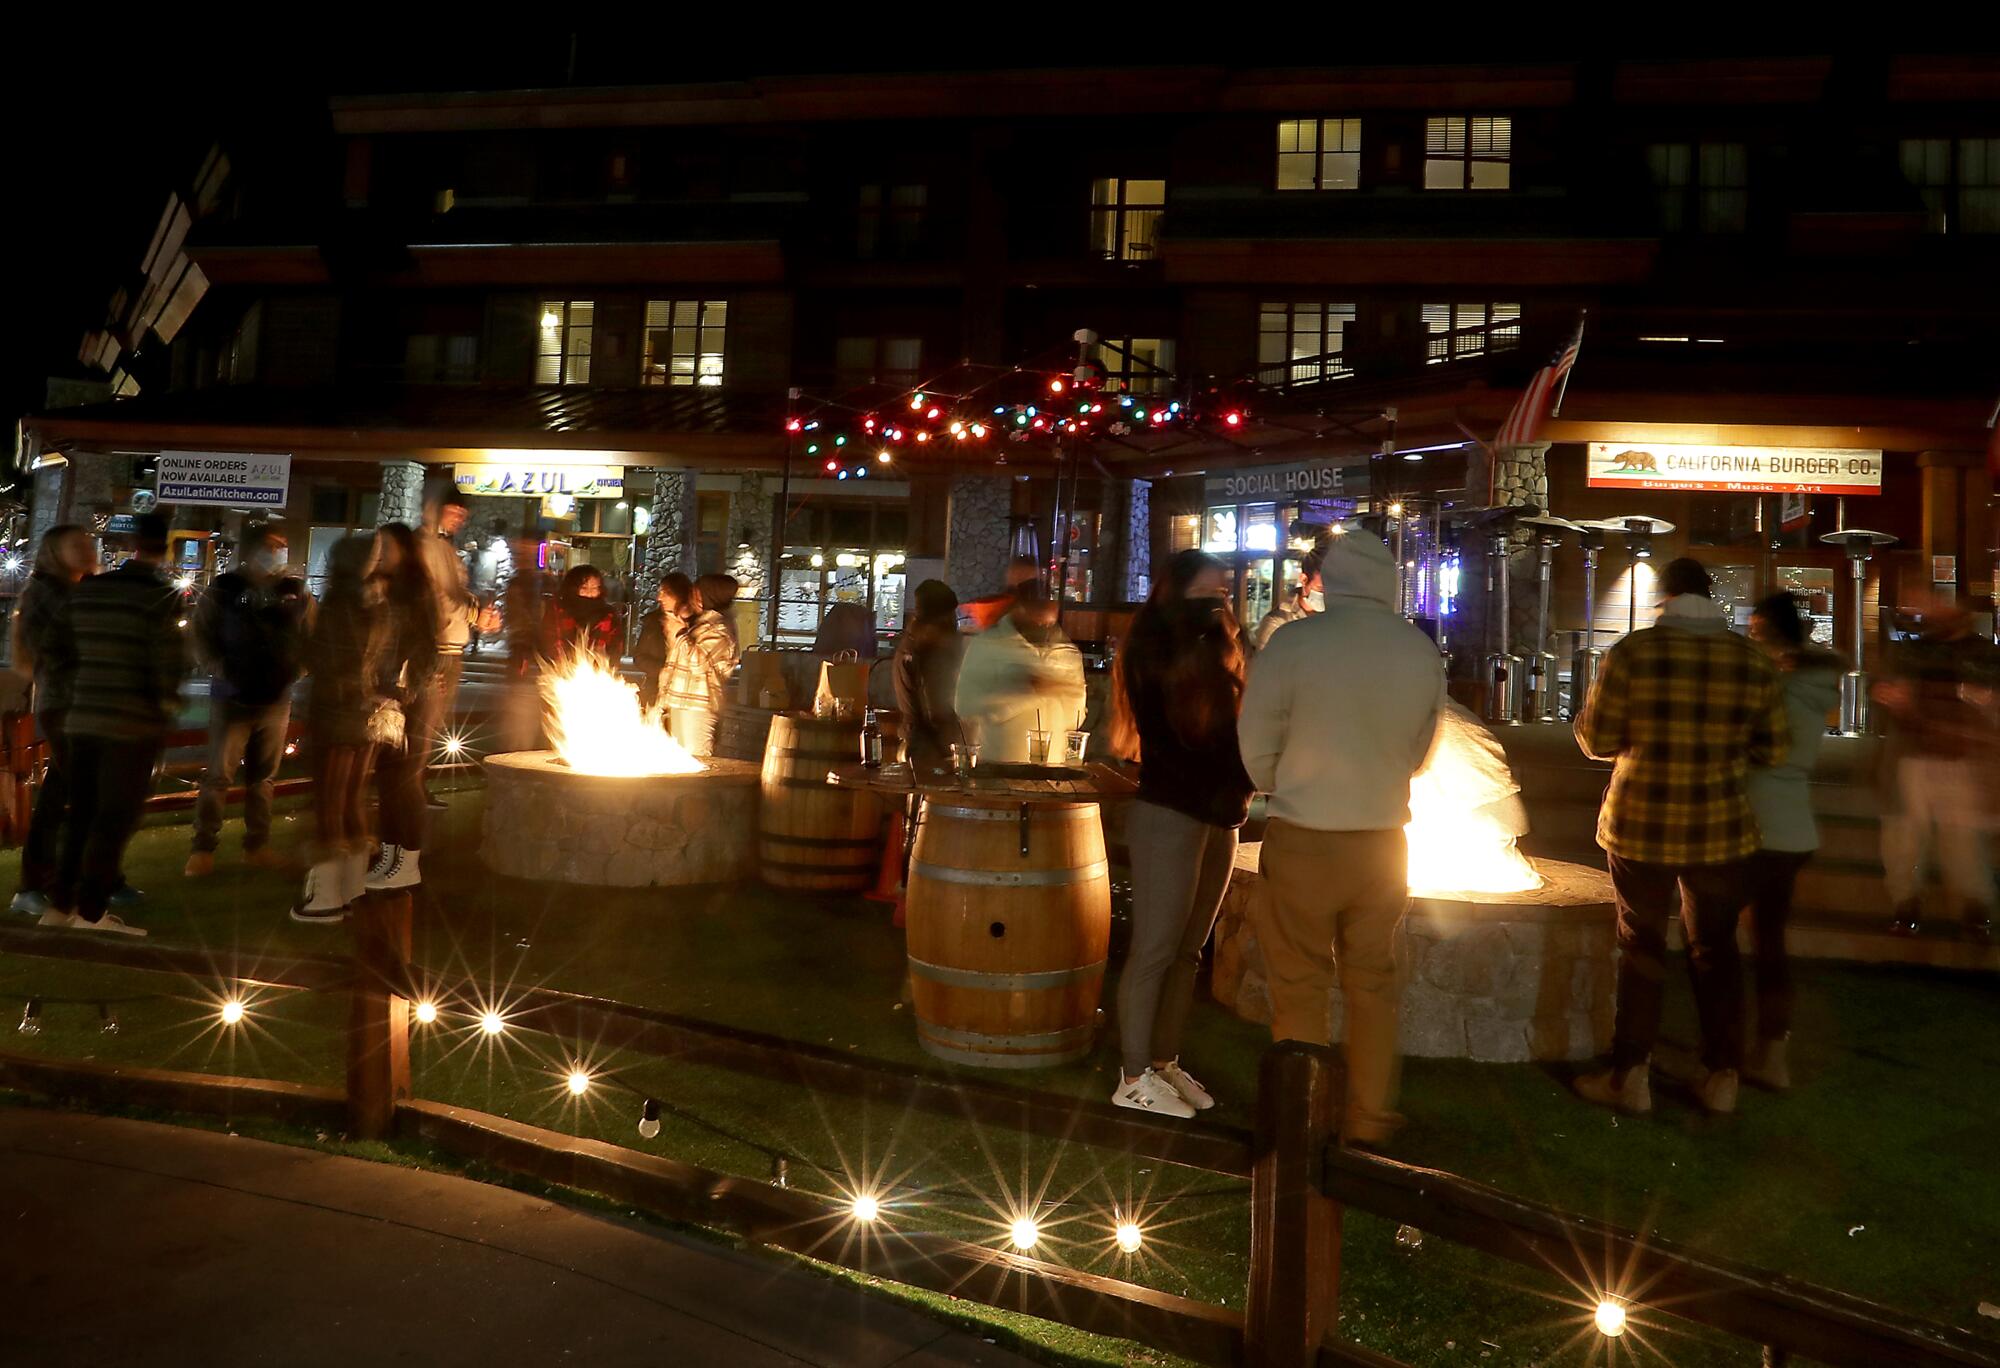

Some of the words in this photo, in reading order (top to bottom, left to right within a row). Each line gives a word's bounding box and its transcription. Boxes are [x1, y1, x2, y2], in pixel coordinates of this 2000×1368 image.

[163, 458, 201, 469] ONLINE
[203, 460, 247, 470] ORDERS
[251, 464, 284, 475] AZUL
[1667, 454, 1760, 472] CALIFORNIA
[1770, 457, 1839, 474] BURGER
[1848, 459, 1878, 475] CO.
[161, 471, 187, 481] NOW
[189, 473, 247, 483] AVAILABLE
[500, 472, 573, 495] AZUL
[1225, 473, 1280, 496] SOCIAL
[1286, 467, 1344, 490] HOUSE
[162, 486, 279, 500] AzulLatinKitchen.com
[1727, 482, 1774, 491] Music
[1795, 484, 1822, 492] Art
